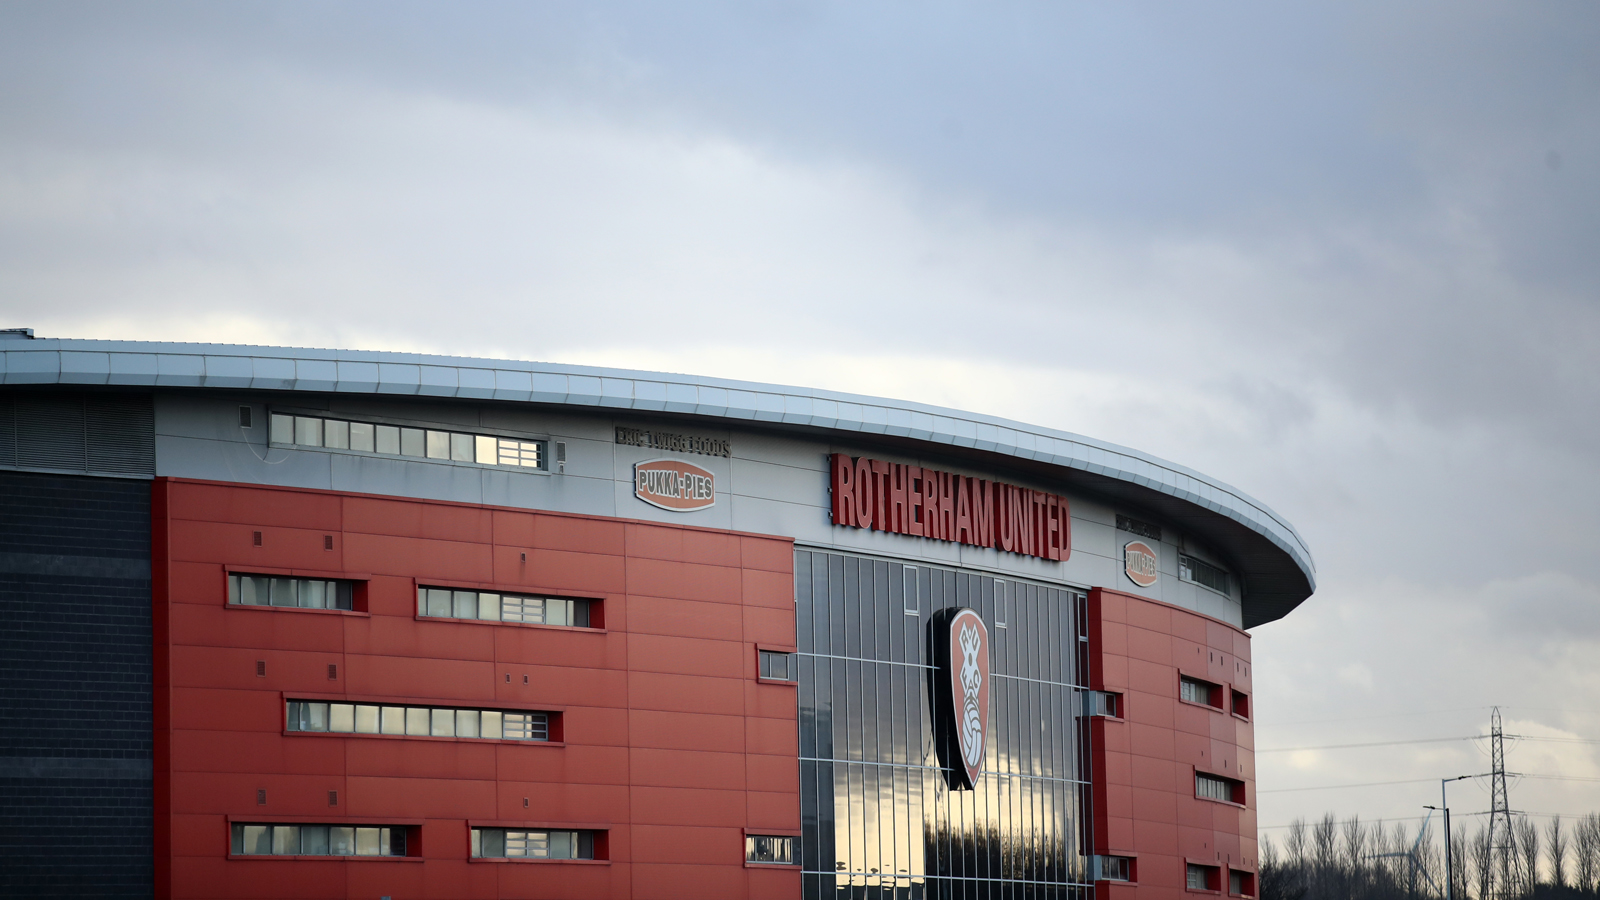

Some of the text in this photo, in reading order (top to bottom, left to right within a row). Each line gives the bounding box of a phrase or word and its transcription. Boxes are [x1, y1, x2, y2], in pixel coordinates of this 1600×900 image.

[615, 427, 732, 458] ERIC TWIGG FOODS
[638, 470, 713, 499] PUKKA-PIES
[832, 453, 1071, 562] ROTHERHAM UNITED
